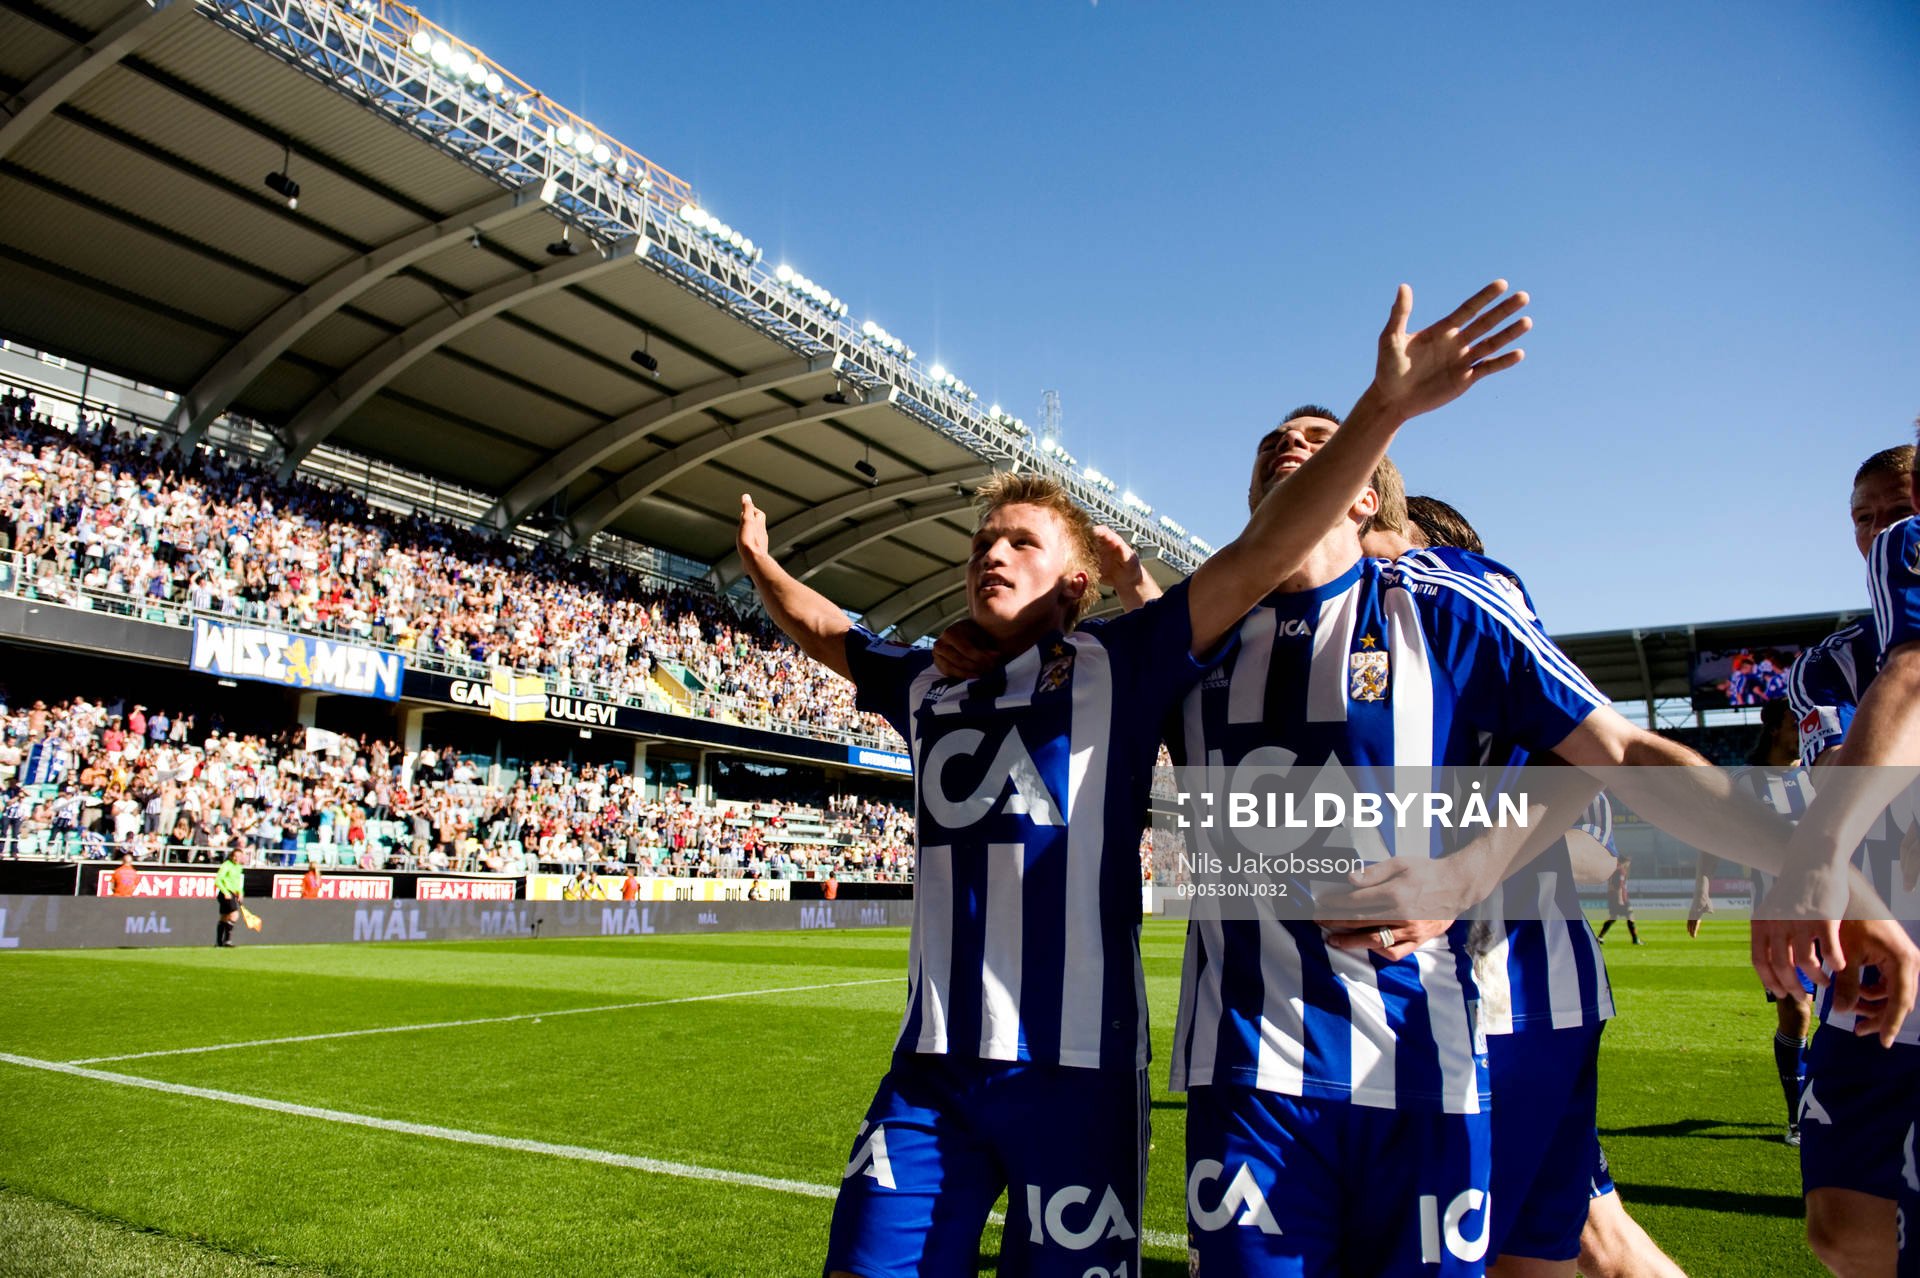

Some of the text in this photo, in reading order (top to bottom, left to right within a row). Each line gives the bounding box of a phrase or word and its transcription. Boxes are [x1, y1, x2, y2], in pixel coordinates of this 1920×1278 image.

[1278, 618, 1313, 638] ICA
[195, 618, 399, 697] WISE MEN
[550, 698, 619, 727] ULLEVI
[103, 875, 175, 898] TAM
[278, 879, 336, 899] TEM
[421, 882, 468, 899] TEAM
[125, 911, 172, 934] MÅL
[353, 899, 427, 940] MÅL
[480, 902, 532, 935] MÅL
[601, 900, 655, 935] MÅL
[698, 909, 719, 924] MÅL
[801, 901, 837, 929] MÅL
[1026, 1183, 1137, 1251] ICA
